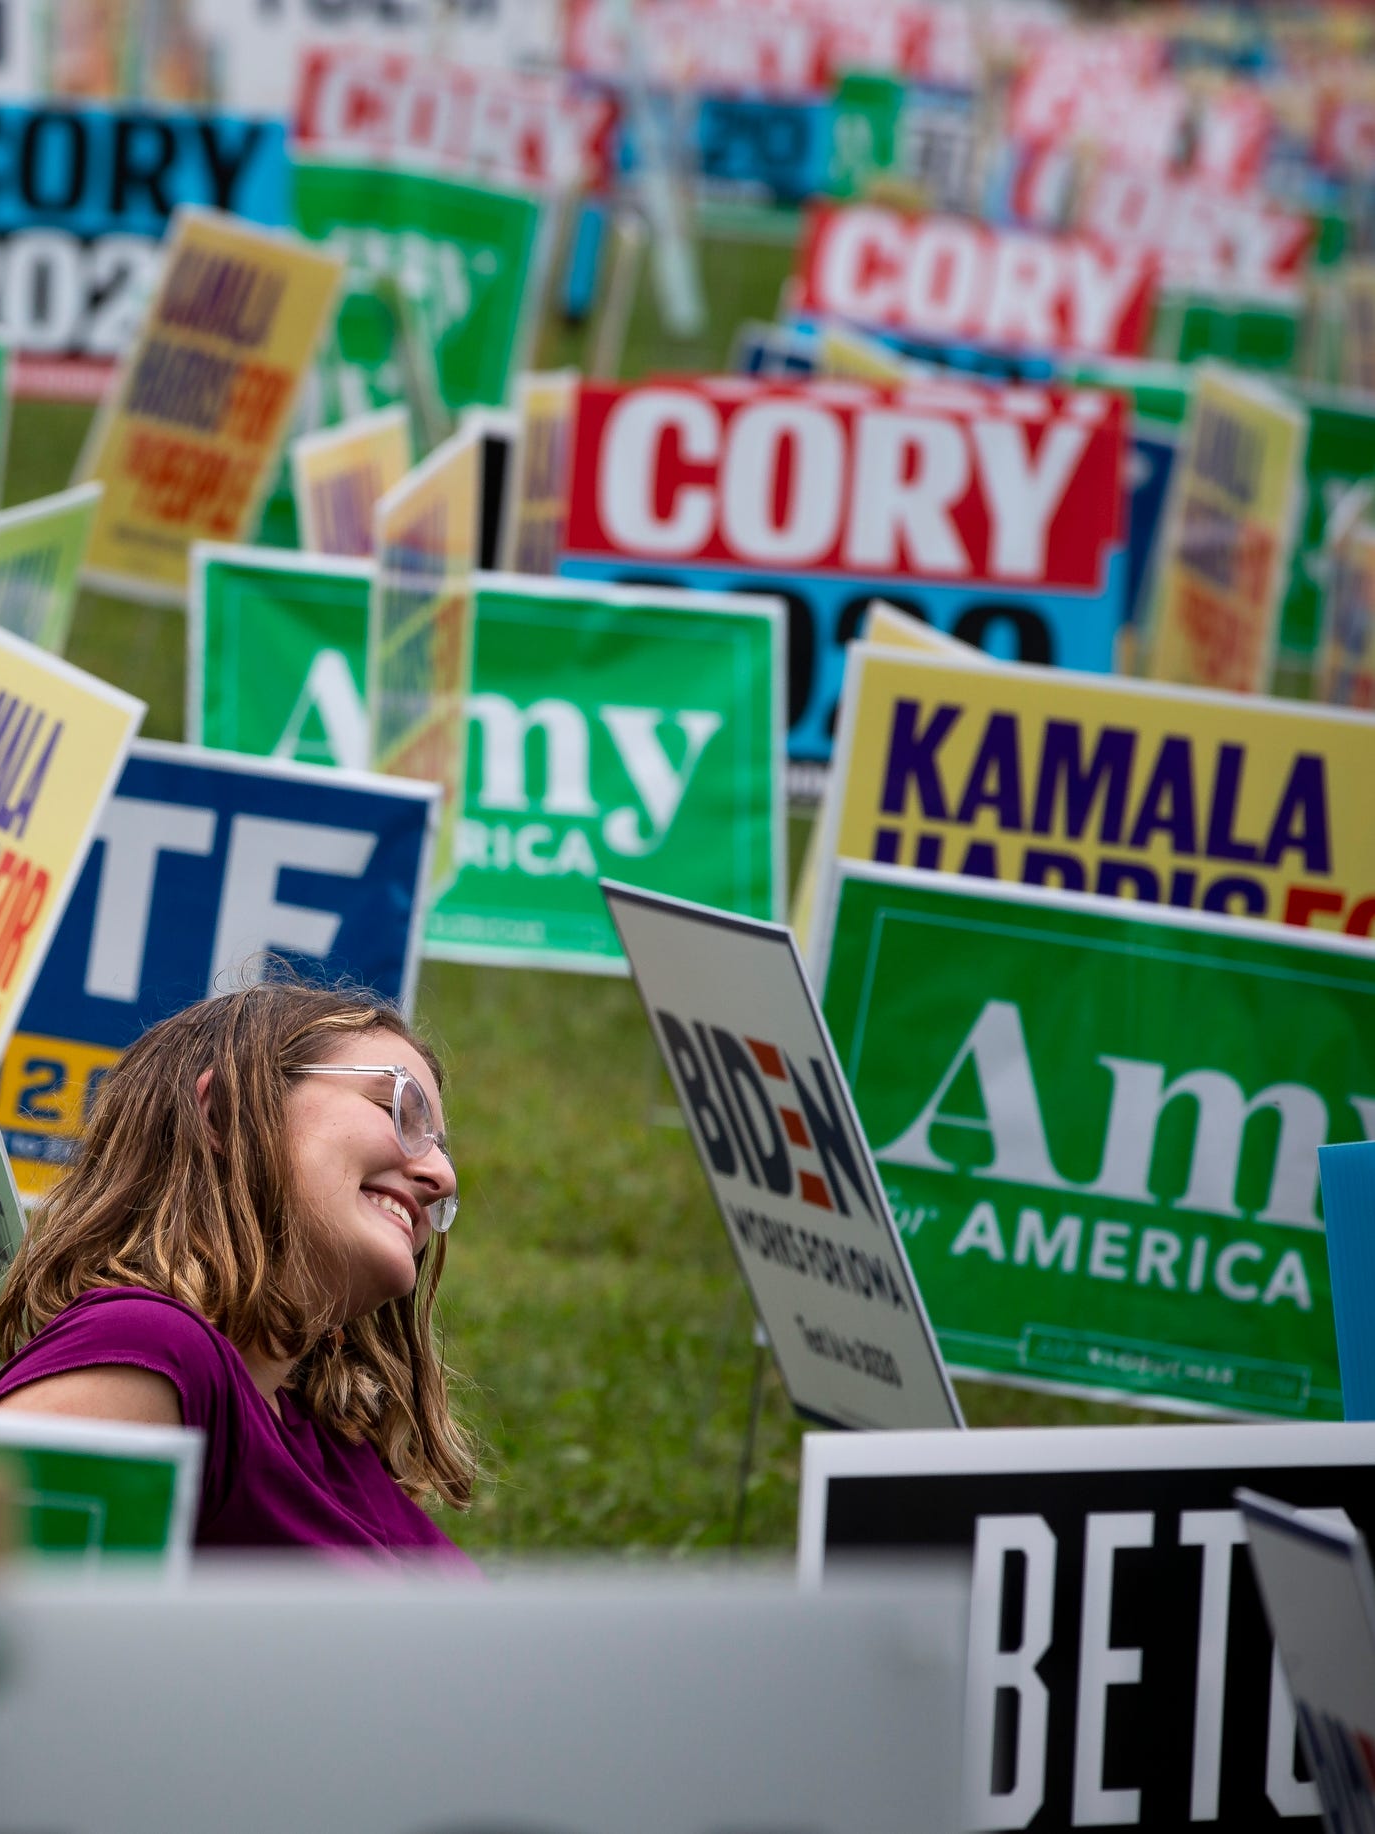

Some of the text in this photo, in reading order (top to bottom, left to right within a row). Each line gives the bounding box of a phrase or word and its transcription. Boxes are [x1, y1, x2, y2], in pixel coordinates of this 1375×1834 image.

[821, 207, 1140, 362] CORY
[595, 390, 1095, 580] CORY
[877, 695, 1335, 878] KAMALA
[656, 1008, 880, 1229] BIDEN
[872, 998, 1375, 1232] Am
[948, 1200, 1316, 1313] AMERICA
